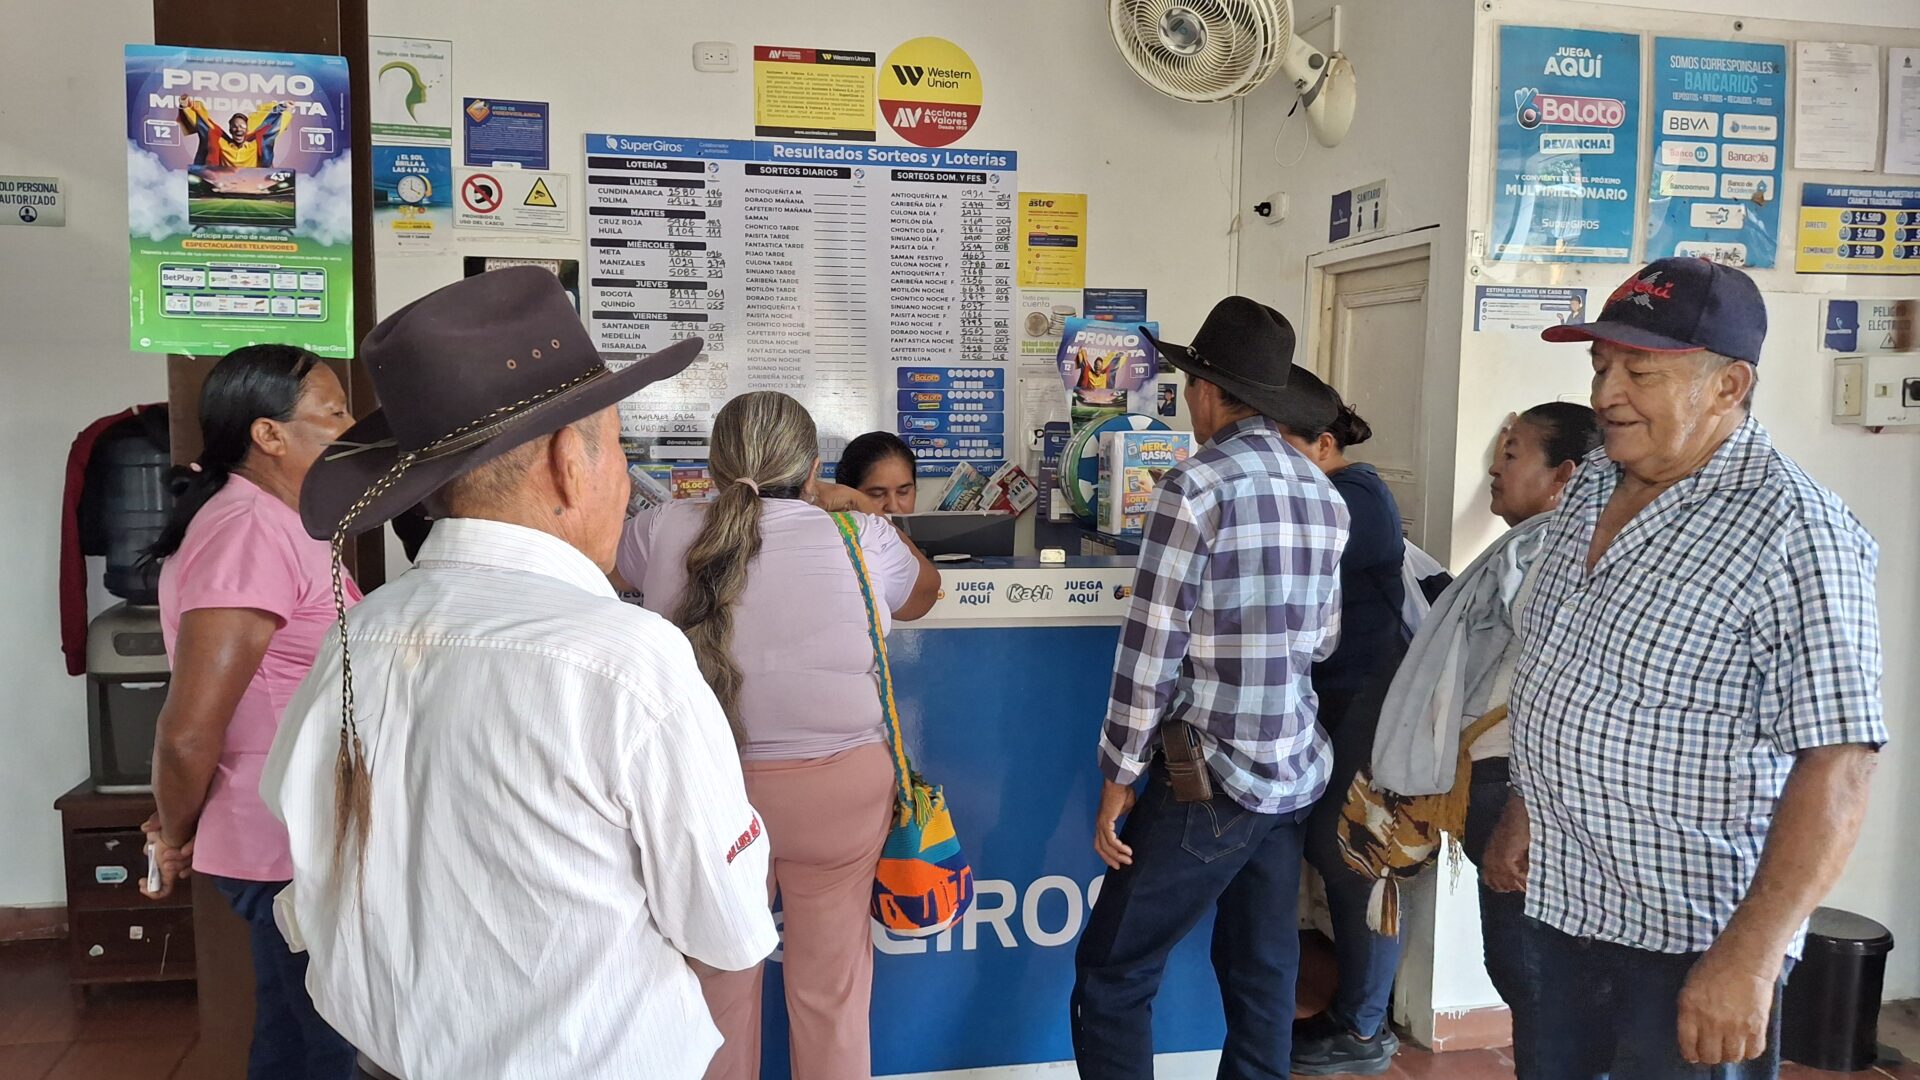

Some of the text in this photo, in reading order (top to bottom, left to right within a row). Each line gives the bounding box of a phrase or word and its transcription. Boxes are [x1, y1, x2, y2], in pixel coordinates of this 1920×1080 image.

[1556, 47, 1591, 57] JUEGA
[1544, 55, 1603, 78] AQUÍ
[1670, 55, 1773, 74] SOMOS CORRESPONSALES
[927, 67, 971, 79] Western
[163, 68, 314, 96] PROMO
[927, 78, 959, 89] Union
[1684, 71, 1758, 94] BANCARIOS
[924, 108, 967, 118] Acciones
[1542, 98, 1622, 124] Baloto
[924, 116, 967, 126] &Valores
[1670, 117, 1709, 130] BBVA
[154, 126, 171, 138] 12
[308, 133, 325, 146] 10
[1544, 139, 1611, 149] REVANCHA!
[620, 139, 682, 153] SuperGiros
[773, 144, 1007, 167] Resultados Sorteos y Loterías
[626, 160, 668, 169] LOTERÍAS
[760, 166, 838, 176] SORTEOS DIARIOS
[629, 178, 658, 186] LUNES
[937, 173, 958, 181] DOM.
[1591, 176, 1621, 184] PRÓXIMO
[0, 182, 59, 193] OLO PERSONAL
[598, 188, 663, 197] CUNDINAMARCA
[1505, 184, 1628, 200] MULTIMILLONARIO
[0, 195, 56, 205] AUTORIZADO
[631, 209, 665, 217] MARTES
[192, 232, 221, 240] Participa
[249, 243, 294, 251] TELEVISORES
[627, 240, 675, 249] MIÉRCOLES
[600, 259, 646, 267] MANIZALES
[163, 273, 194, 283] BetPlay
[635, 280, 669, 288] JUEVES
[601, 300, 635, 308] QUINDÍO
[633, 312, 668, 320] VIERNES
[602, 322, 650, 330] SANTANDER
[1074, 331, 1139, 347] PROMO
[602, 342, 647, 350] RISARALDA
[1140, 442, 1173, 452] MERCA
[1141, 451, 1172, 460] RASPA
[955, 582, 995, 591] JUEGA
[1065, 581, 1103, 590] JUEGA
[960, 592, 991, 605] AQUÍ
[1068, 591, 1099, 604] AQUÍ
